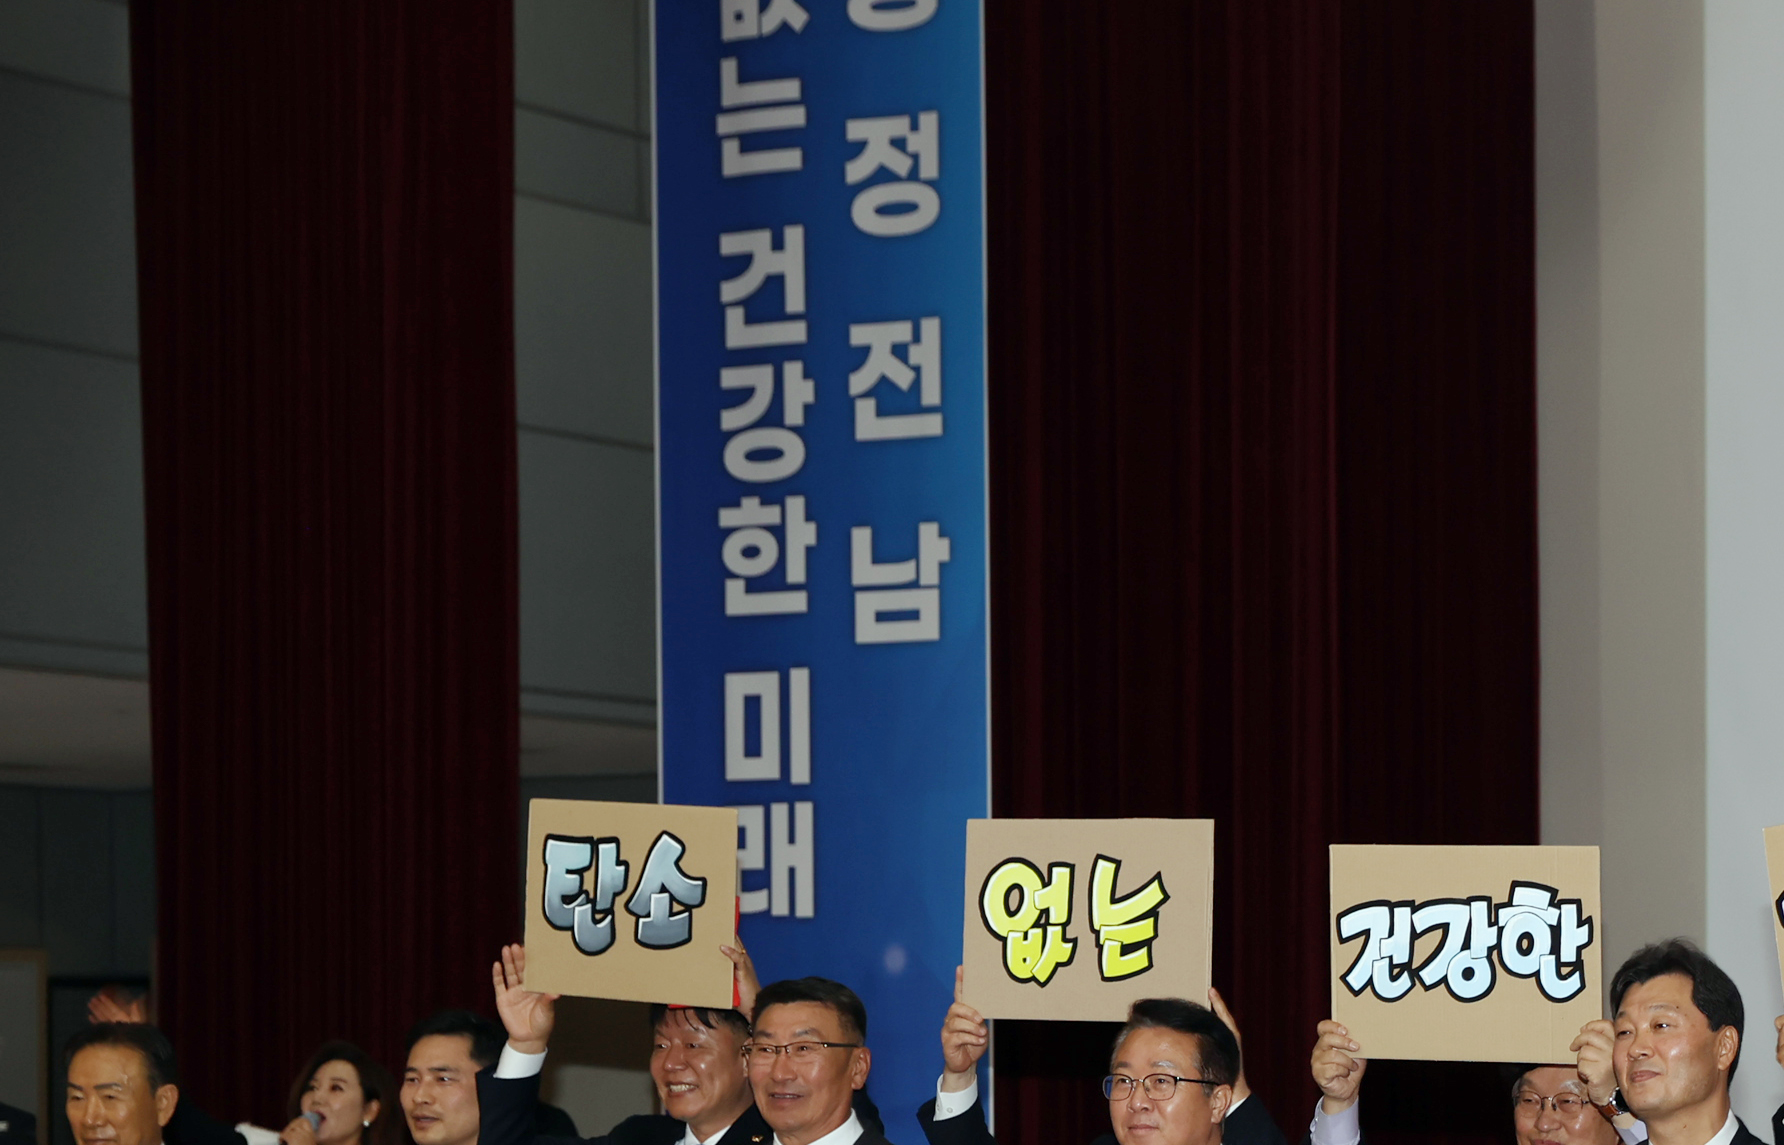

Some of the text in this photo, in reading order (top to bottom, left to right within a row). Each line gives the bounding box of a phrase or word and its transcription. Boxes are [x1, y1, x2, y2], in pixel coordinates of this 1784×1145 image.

[716, 224, 817, 617] 건강한
[722, 667, 814, 921] 미래
[543, 831, 706, 955] 탄소
[980, 853, 1169, 986] 없는
[1336, 880, 1592, 1003] 건강한
